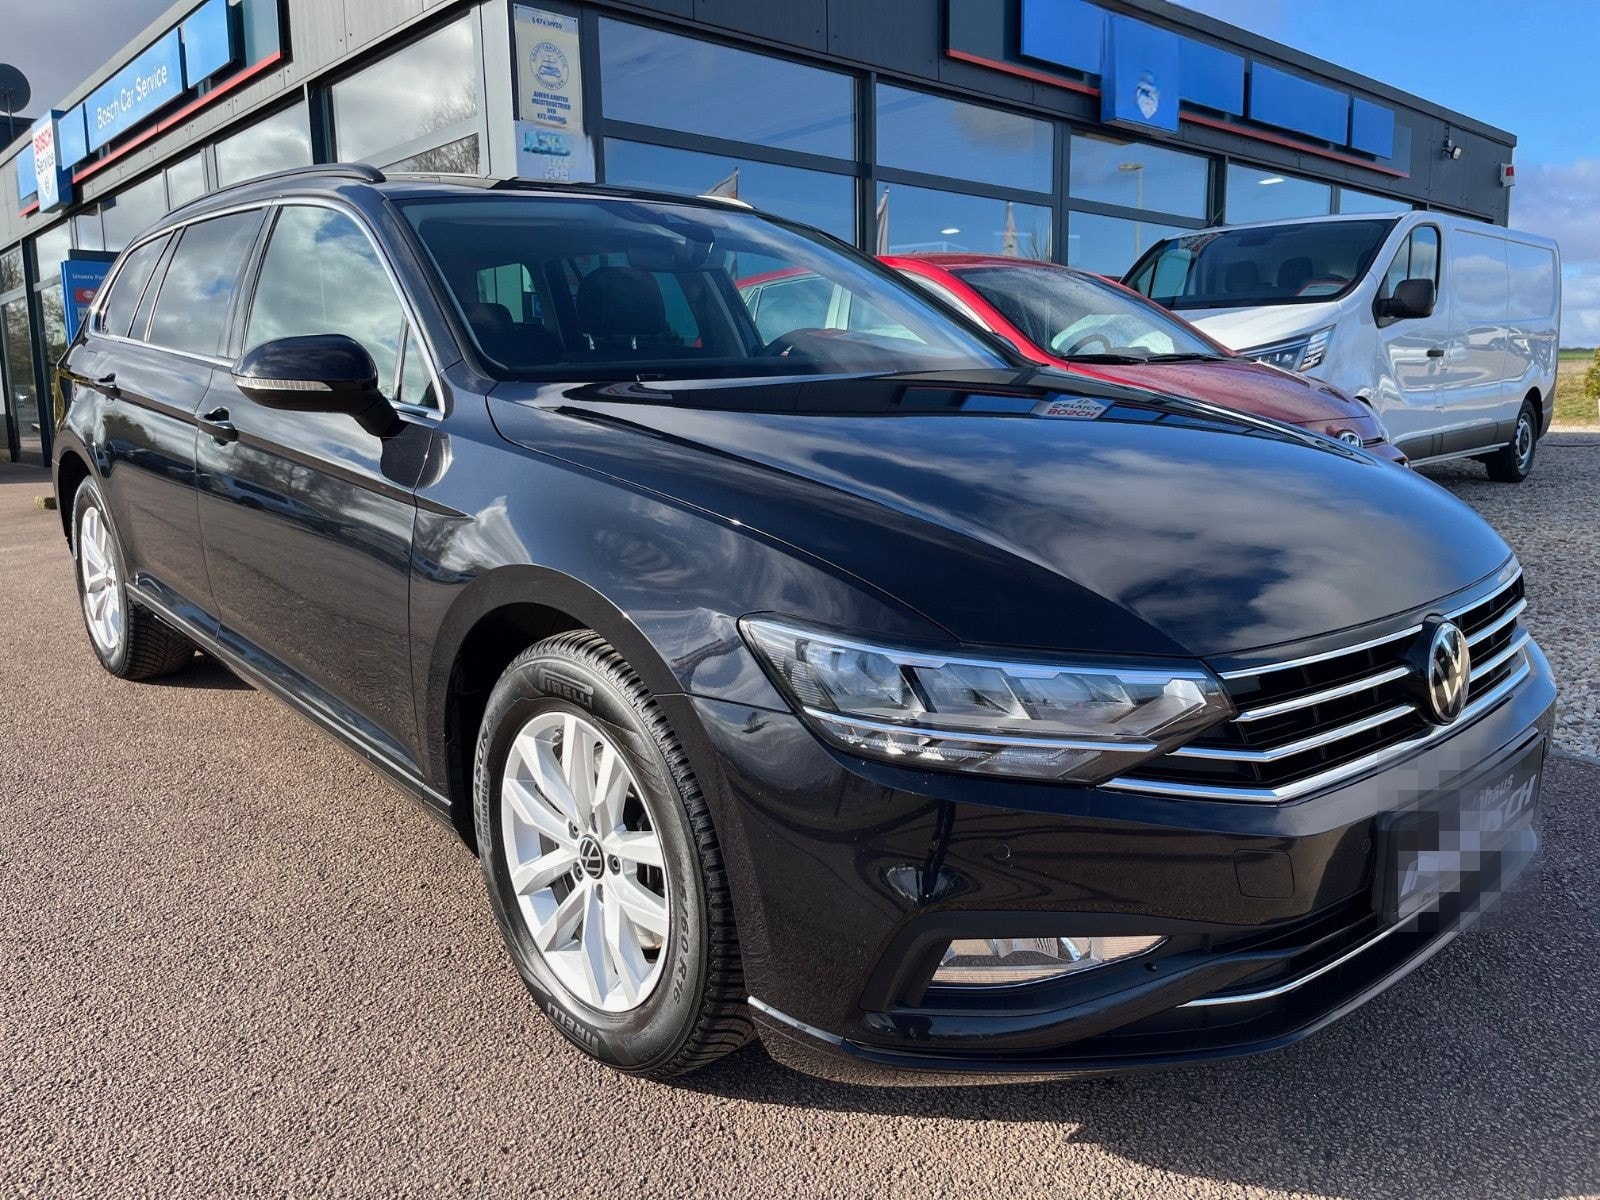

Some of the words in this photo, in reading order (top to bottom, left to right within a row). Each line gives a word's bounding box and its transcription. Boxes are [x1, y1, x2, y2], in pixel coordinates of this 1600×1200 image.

[97, 97, 119, 129] Bosch
[120, 88, 134, 112] Car
[136, 65, 168, 102] Service
[33, 126, 52, 155] BOSCH
[35, 152, 54, 176] Service
[538, 668, 594, 711] PIRELLI
